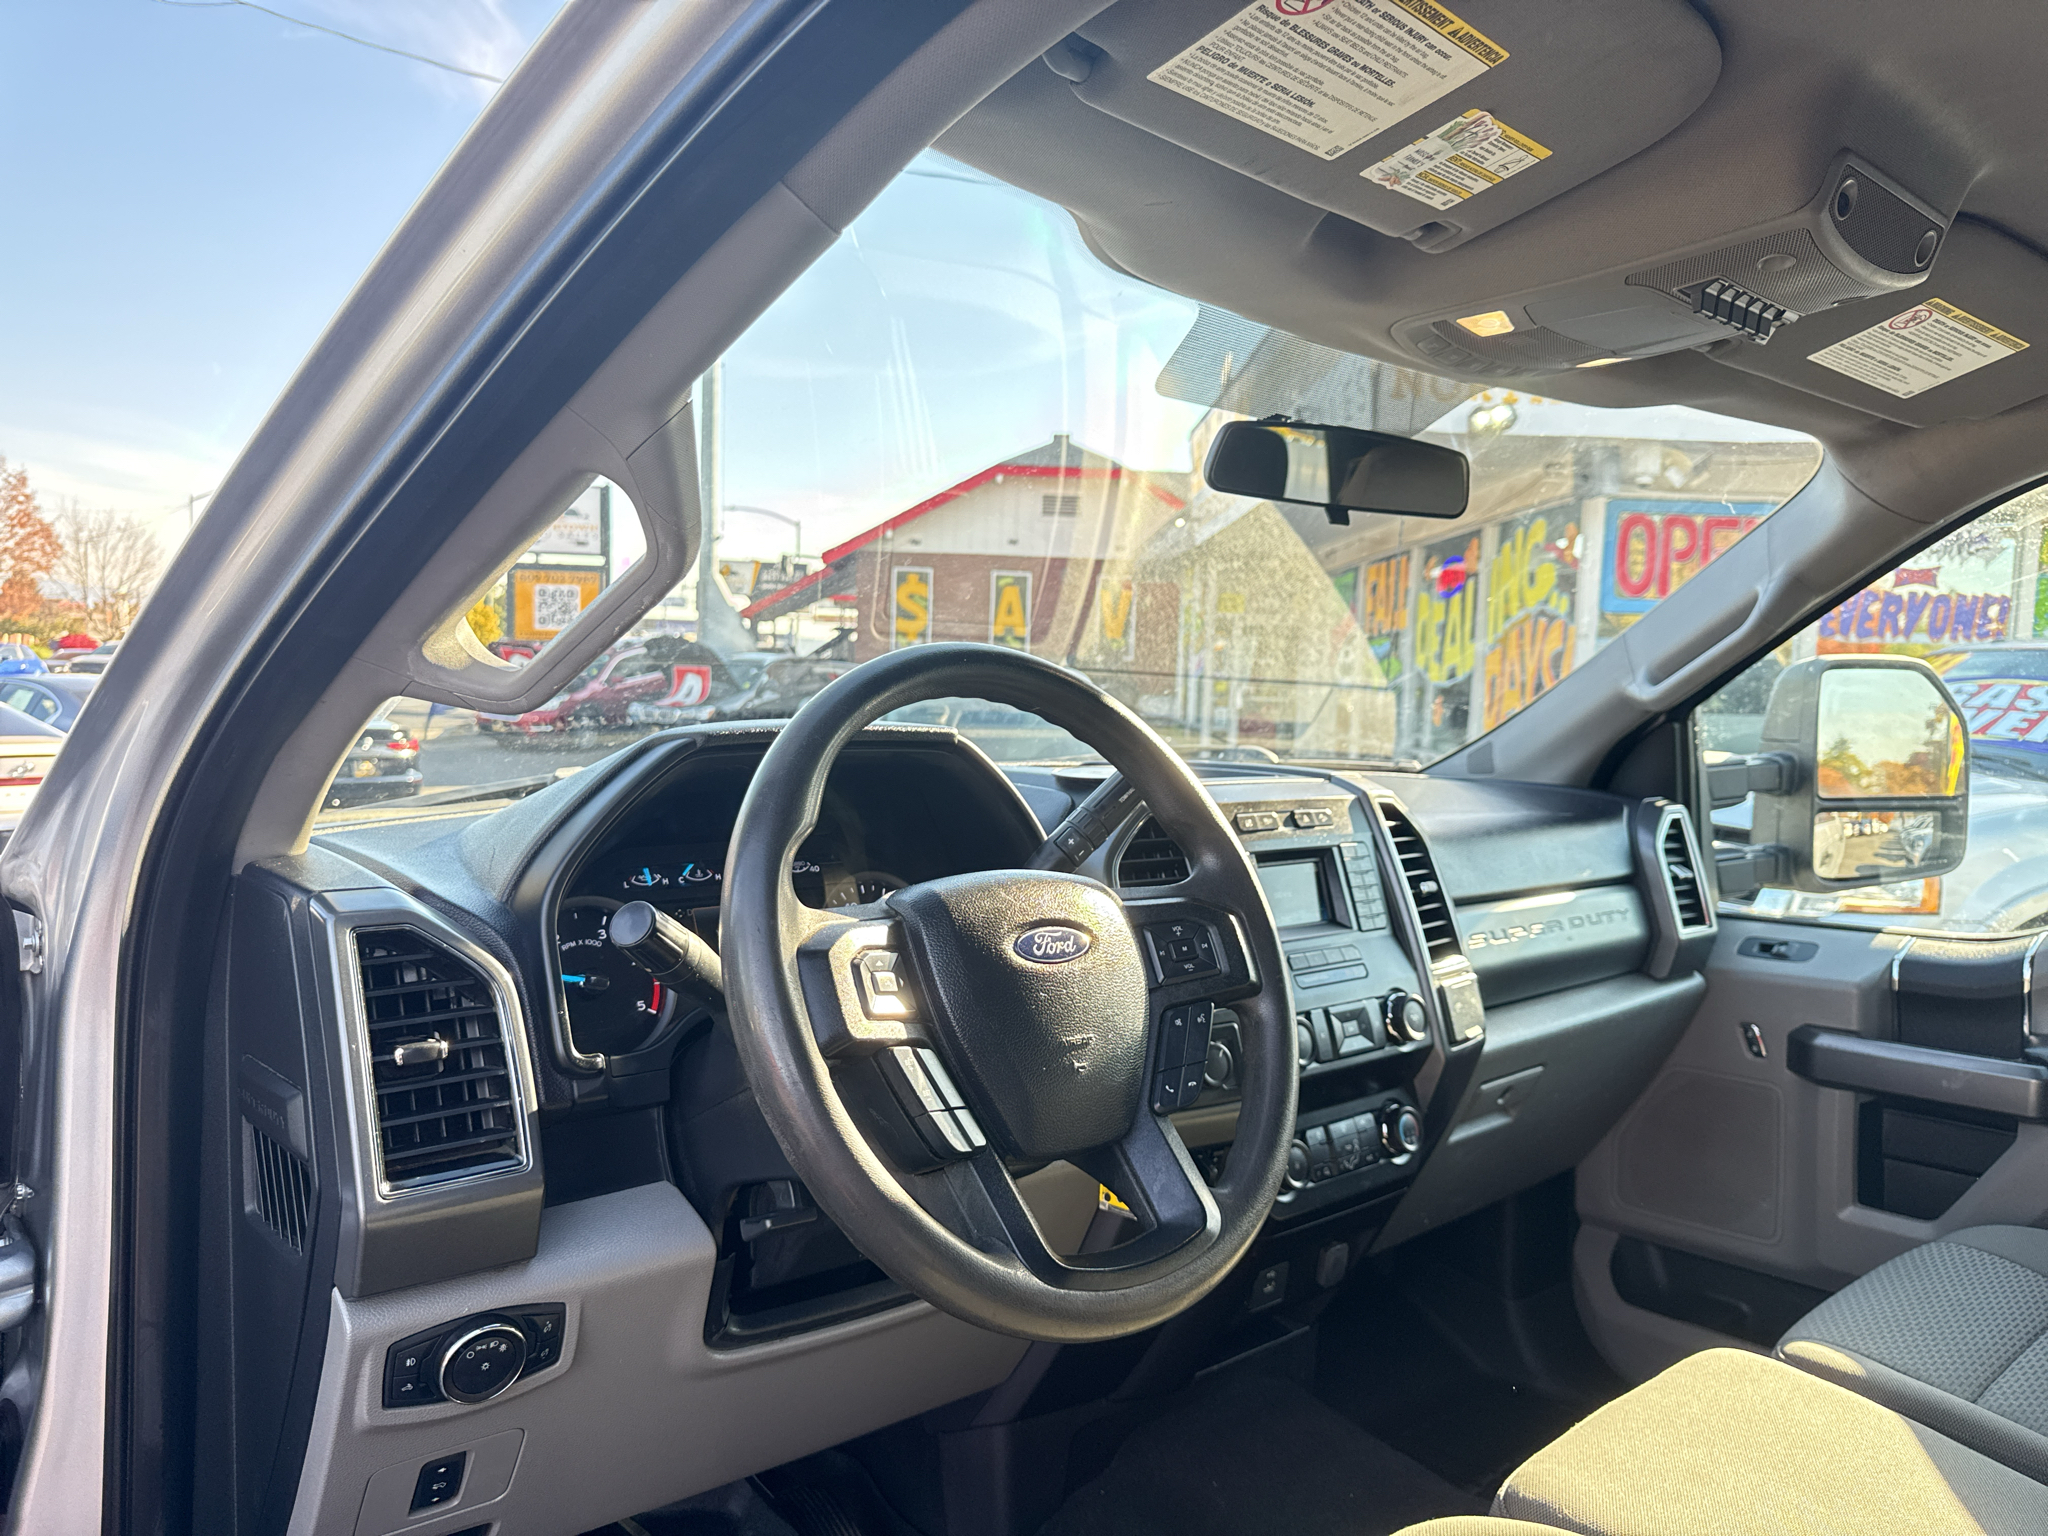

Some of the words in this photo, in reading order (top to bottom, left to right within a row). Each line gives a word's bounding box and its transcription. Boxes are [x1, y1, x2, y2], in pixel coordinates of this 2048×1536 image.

[1253, 4, 1284, 22] Risque
[1278, 18, 1293, 26] de
[1288, 23, 1331, 48] BLESSURES
[1326, 45, 1355, 62] GRAVES
[1358, 64, 1398, 87] MORTELLES.
[1377, 10, 1408, 30] SERIOUS
[1402, 27, 1429, 43] INJURY
[1423, 41, 1438, 50] can
[1433, 48, 1454, 60] occur.
[1455, 31, 1505, 64] ADVERTENCIA
[1195, 45, 1231, 64] PELIGRO
[1236, 66, 1268, 83] MUERTE
[1269, 82, 1293, 95] SERIA
[1289, 92, 1318, 107] LESIÓN.
[1615, 513, 1759, 598] OPE
[560, 942, 576, 952] RPM
[584, 938, 603, 948] 1000
[596, 929, 608, 940] 3
[1032, 931, 1077, 955] Ford
[1468, 920, 1564, 950] SUPER
[1568, 908, 1631, 930] DUTY
[636, 1000, 646, 1011] 5
